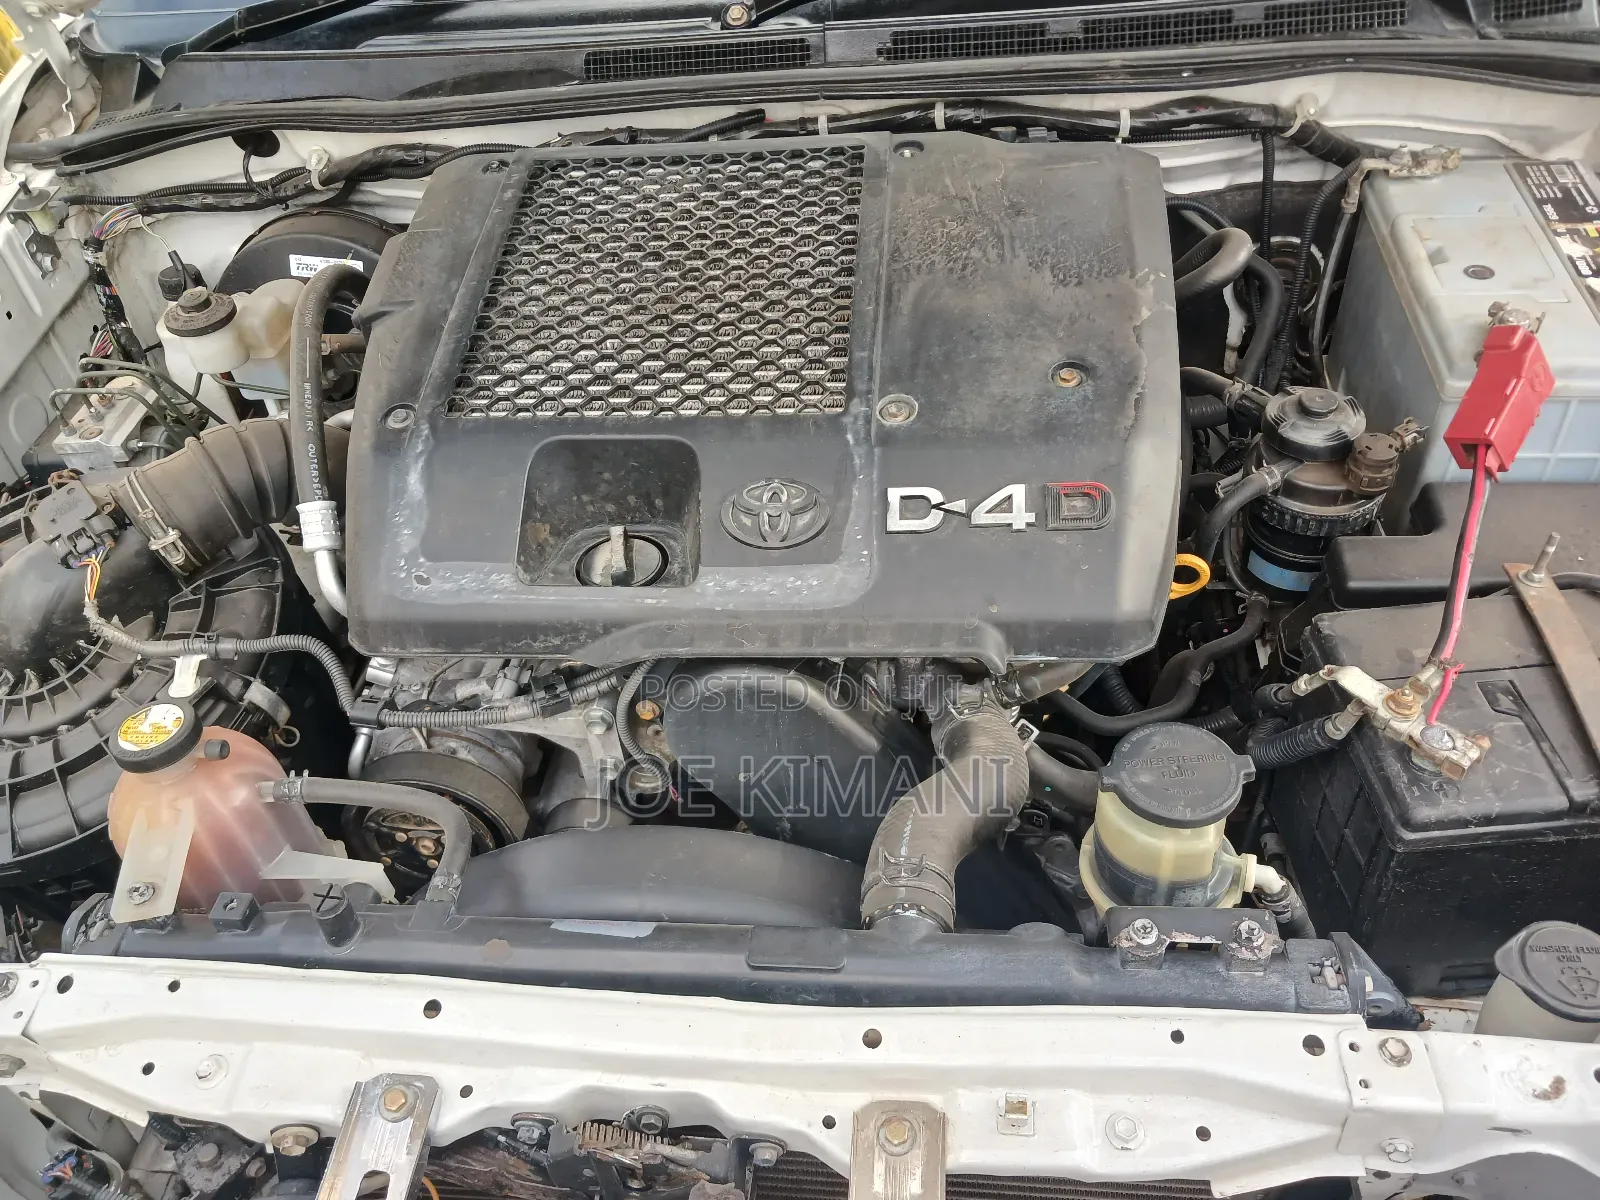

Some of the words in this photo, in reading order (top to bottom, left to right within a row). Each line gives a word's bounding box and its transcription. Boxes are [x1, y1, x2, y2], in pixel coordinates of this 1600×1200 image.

[296, 262, 319, 273] TRW
[1124, 757, 1165, 769] POWER
[1168, 753, 1227, 765] STEERING
[1161, 769, 1197, 779] FLUID
[1529, 945, 1572, 953] WASHER
[1576, 946, 1600, 954] FLUI
